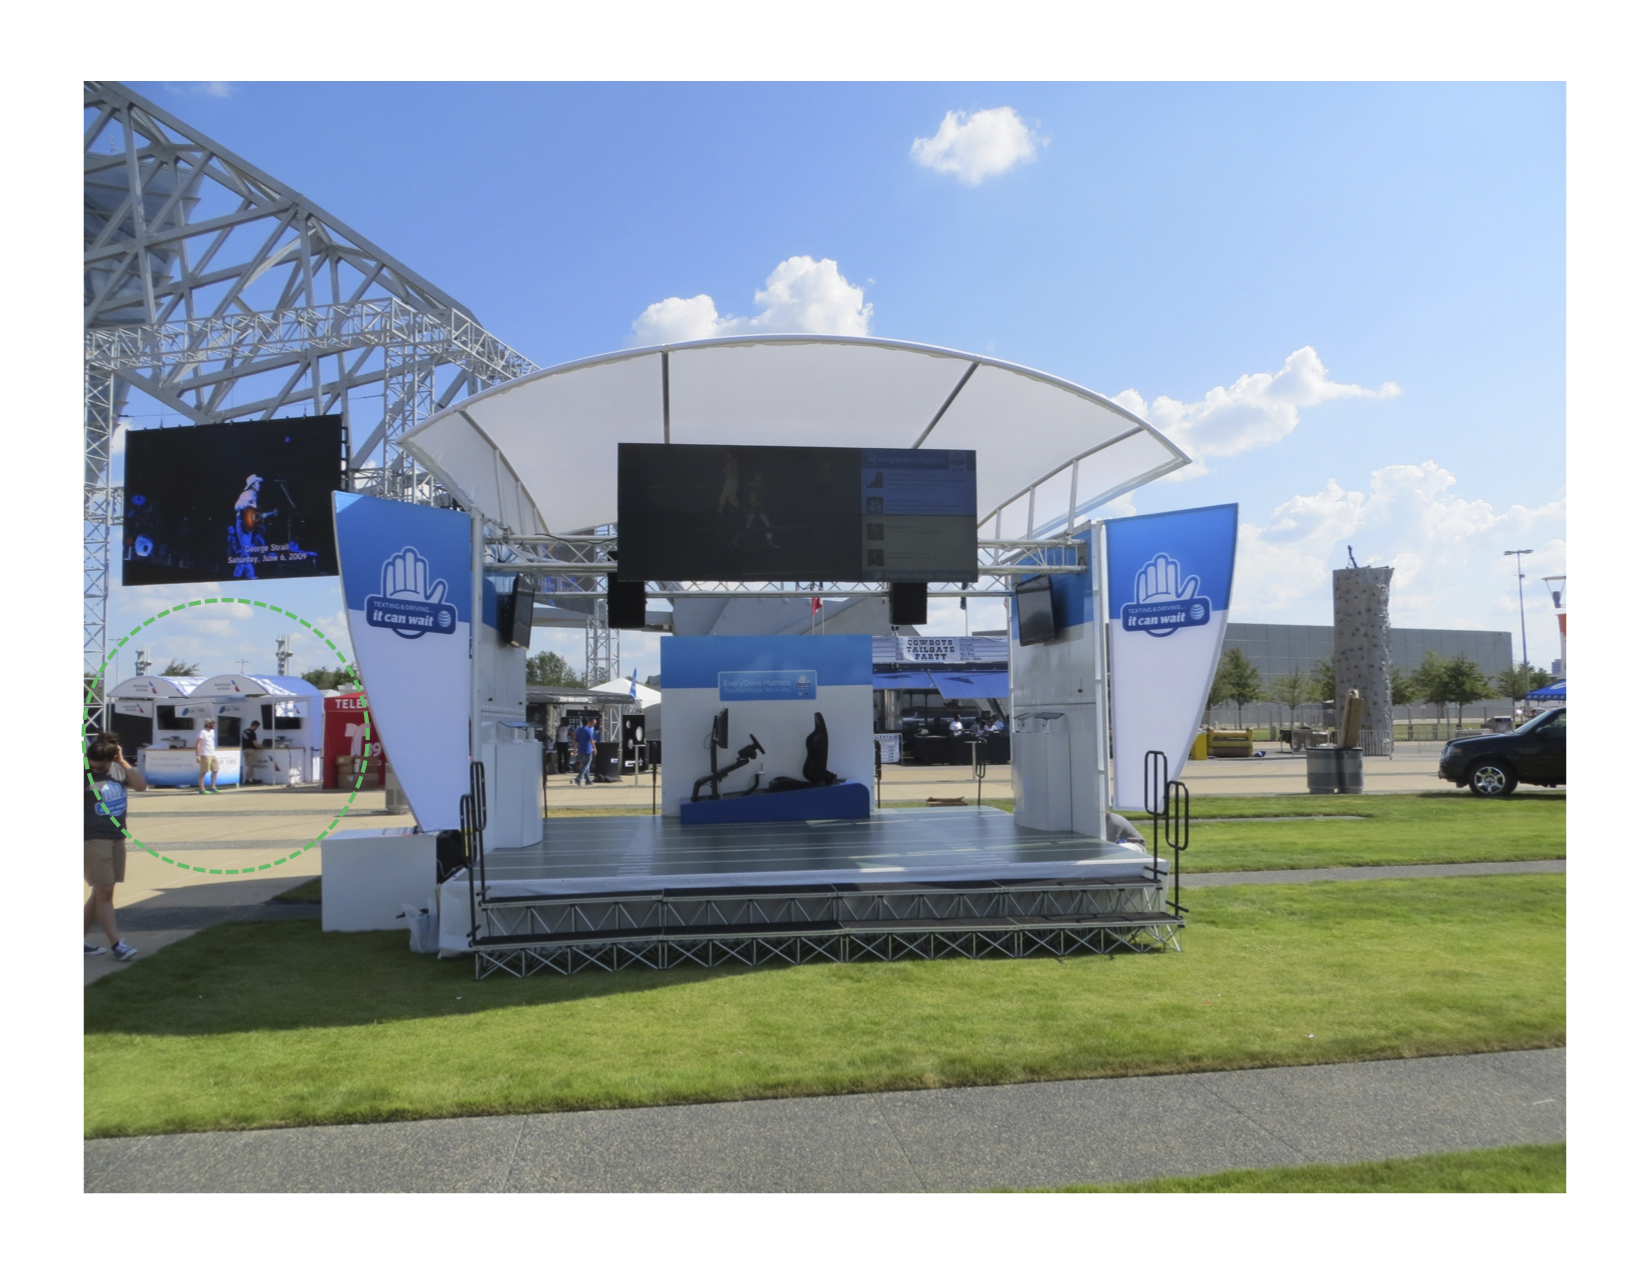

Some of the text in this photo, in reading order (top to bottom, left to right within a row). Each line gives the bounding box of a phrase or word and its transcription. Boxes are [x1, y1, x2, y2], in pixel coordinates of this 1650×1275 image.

[244, 543, 290, 554] George Strait
[288, 552, 307, 560] 2009
[372, 609, 434, 626] it can wait
[1128, 612, 1186, 626] it can wait
[723, 680, 743, 688] Every
[744, 679, 763, 687] Drive
[335, 699, 367, 709] TELE
